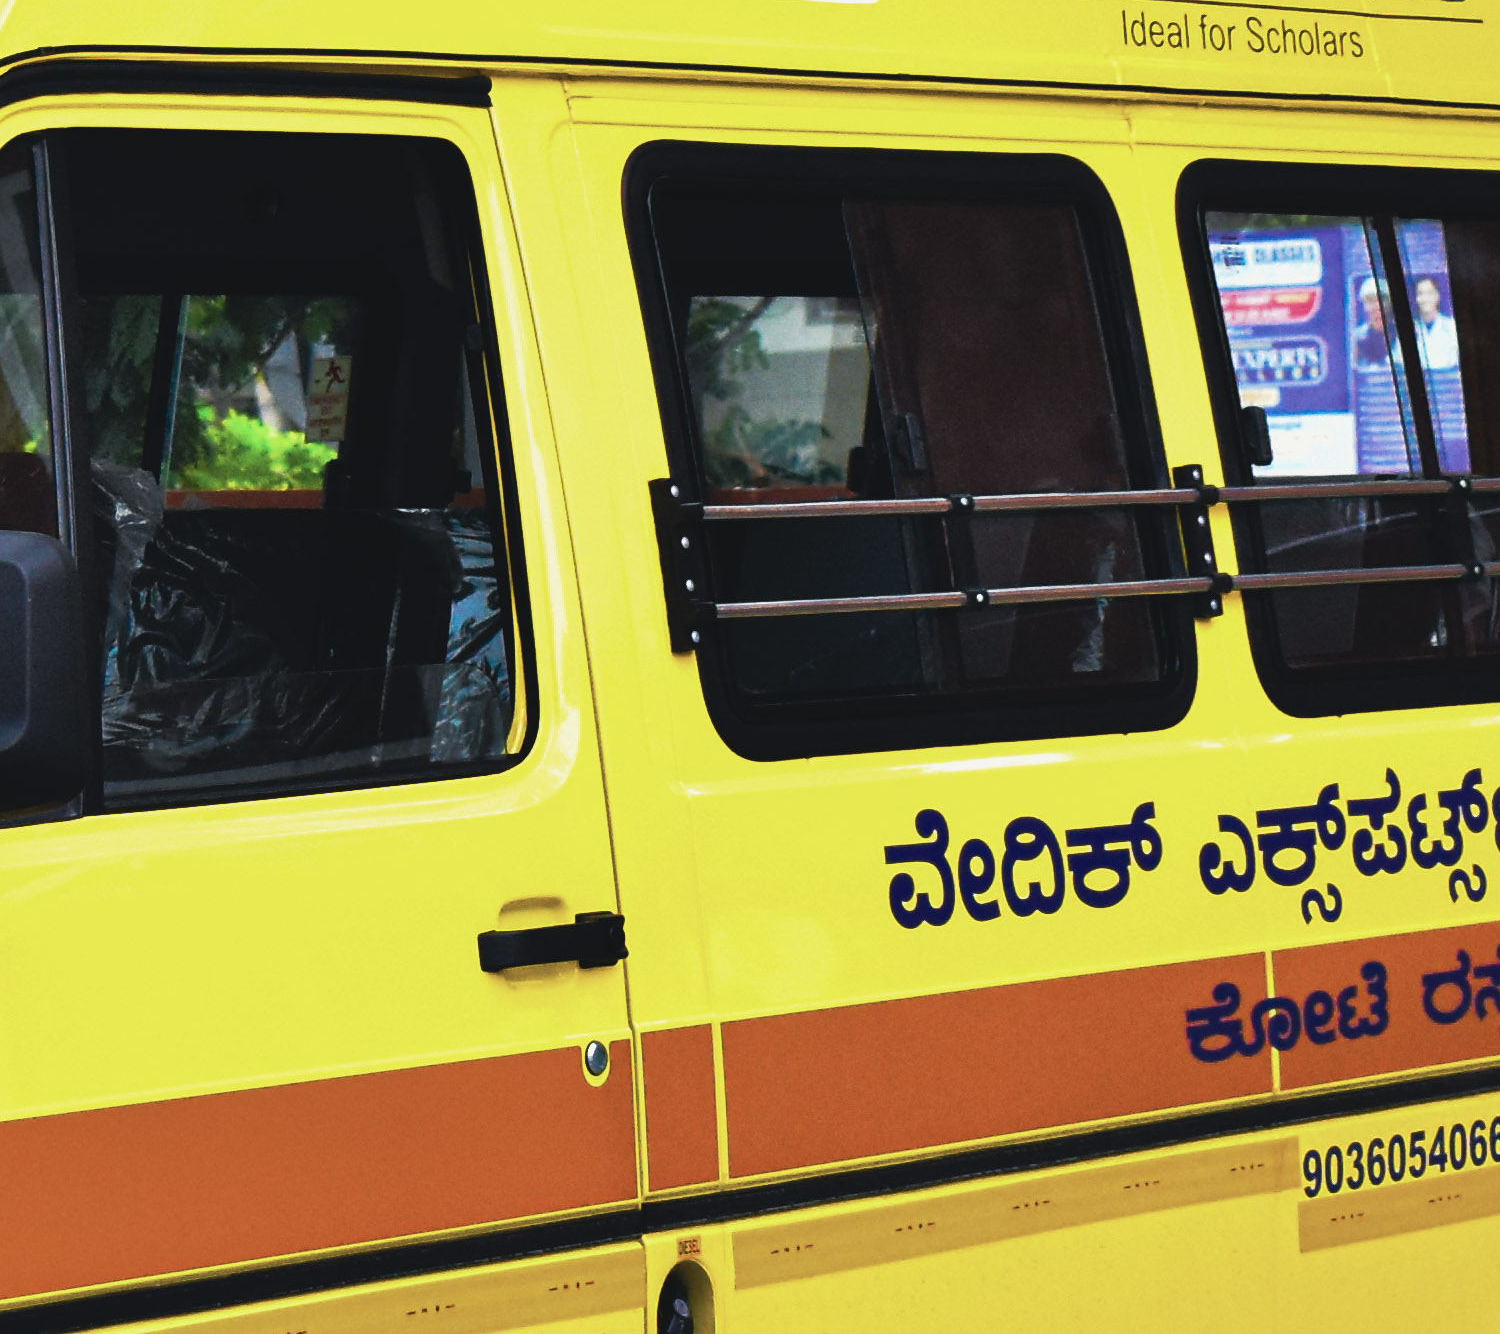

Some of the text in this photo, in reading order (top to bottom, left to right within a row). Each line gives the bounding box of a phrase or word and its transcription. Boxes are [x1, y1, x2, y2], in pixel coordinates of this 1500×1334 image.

[1121, 10, 1365, 58] Ideal for Scholars
[883, 801, 1163, 929] ವೇದಿಕ್
[1185, 959, 1390, 1064] ಕೋಟೆ
[678, 1239, 701, 1255] DIESEL
